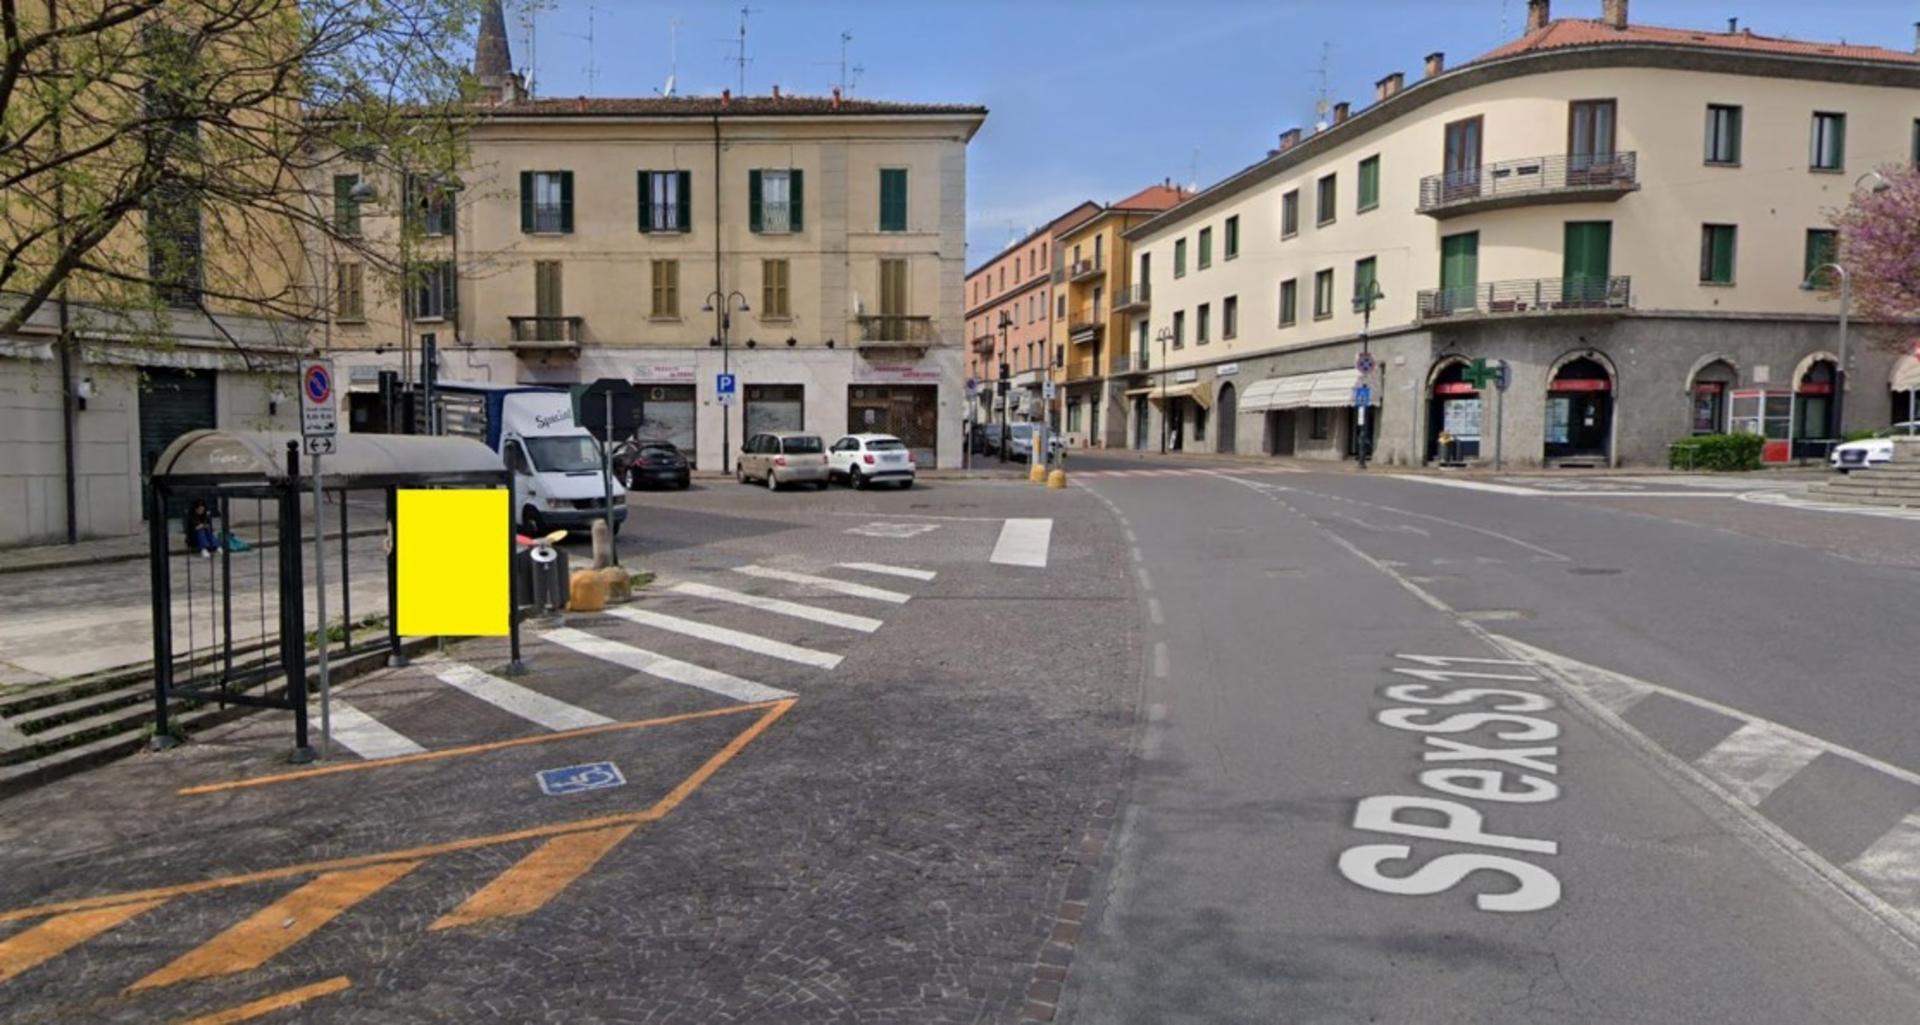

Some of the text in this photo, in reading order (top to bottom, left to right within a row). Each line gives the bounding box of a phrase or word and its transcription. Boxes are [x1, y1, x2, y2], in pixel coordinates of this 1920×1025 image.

[720, 377, 732, 391] P
[535, 408, 571, 429] Special
[1338, 653, 1561, 912] SPexSS11
